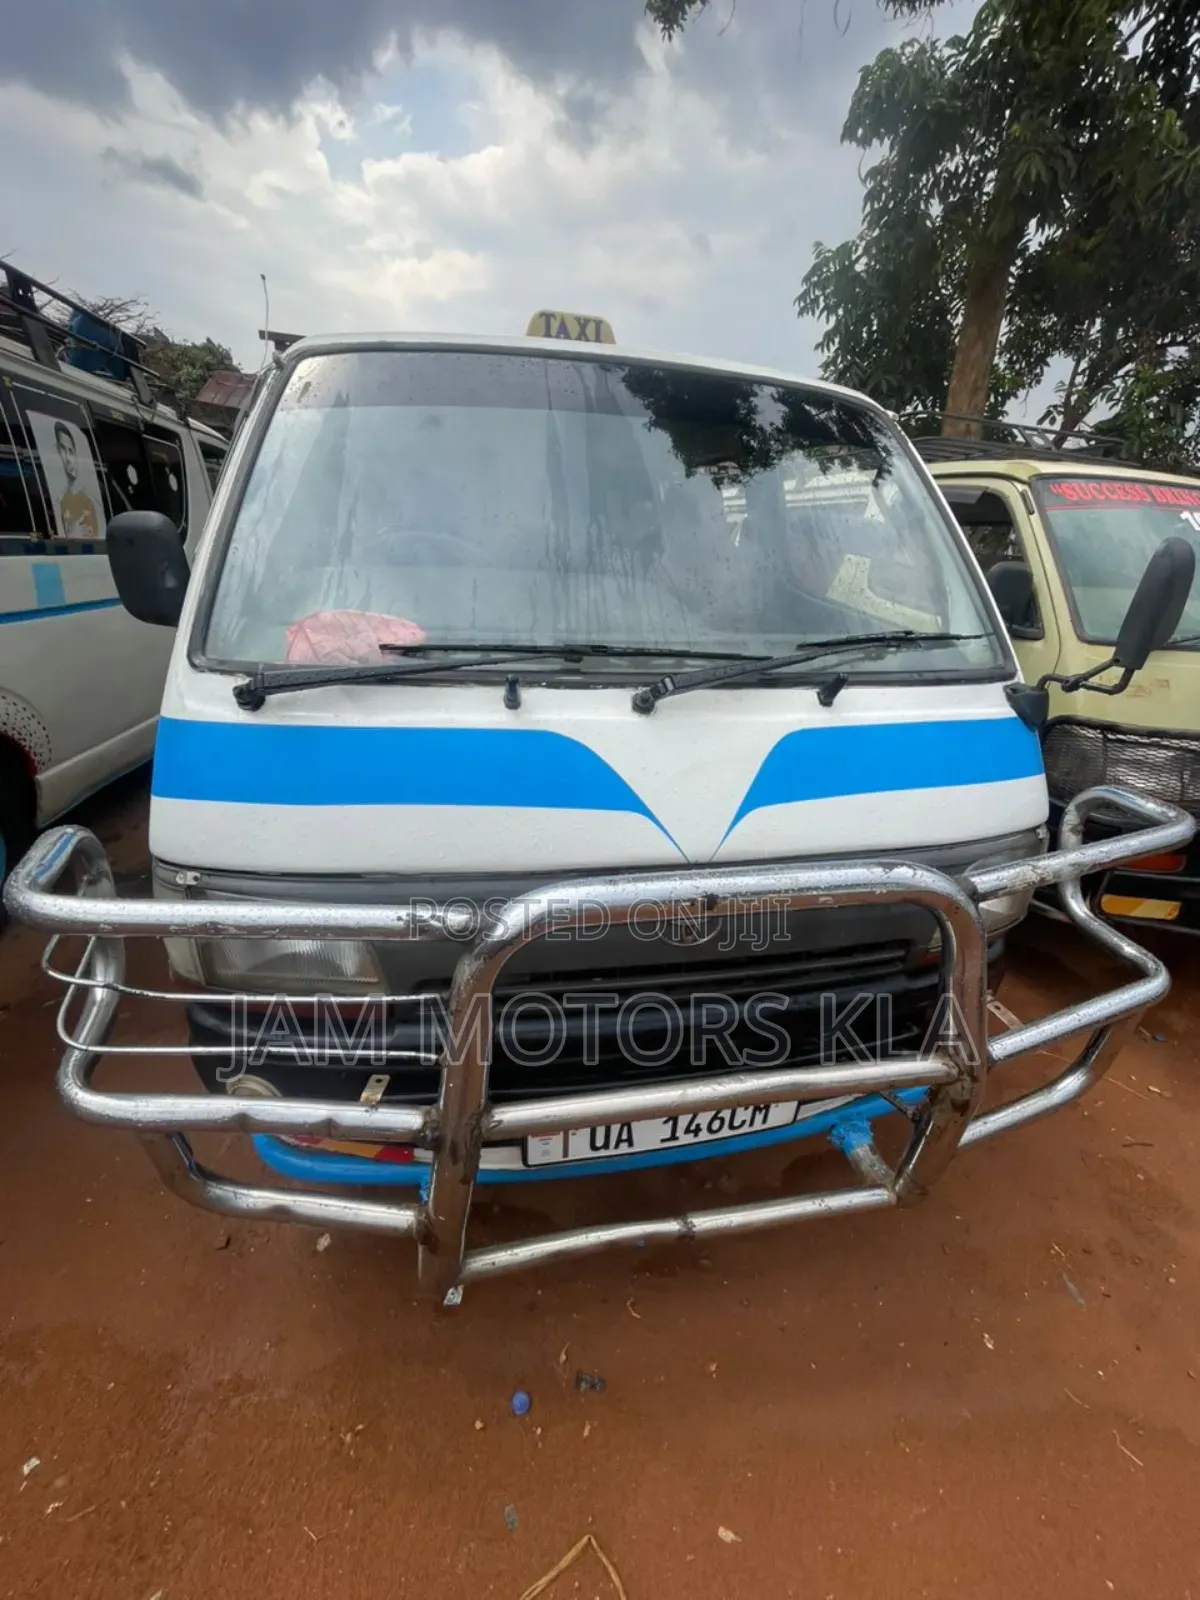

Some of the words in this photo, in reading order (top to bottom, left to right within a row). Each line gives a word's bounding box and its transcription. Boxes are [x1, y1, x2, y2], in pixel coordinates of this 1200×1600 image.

[538, 311, 604, 343] TAXI
[588, 1122, 635, 1152] UA
[659, 1102, 772, 1144] 146CM
